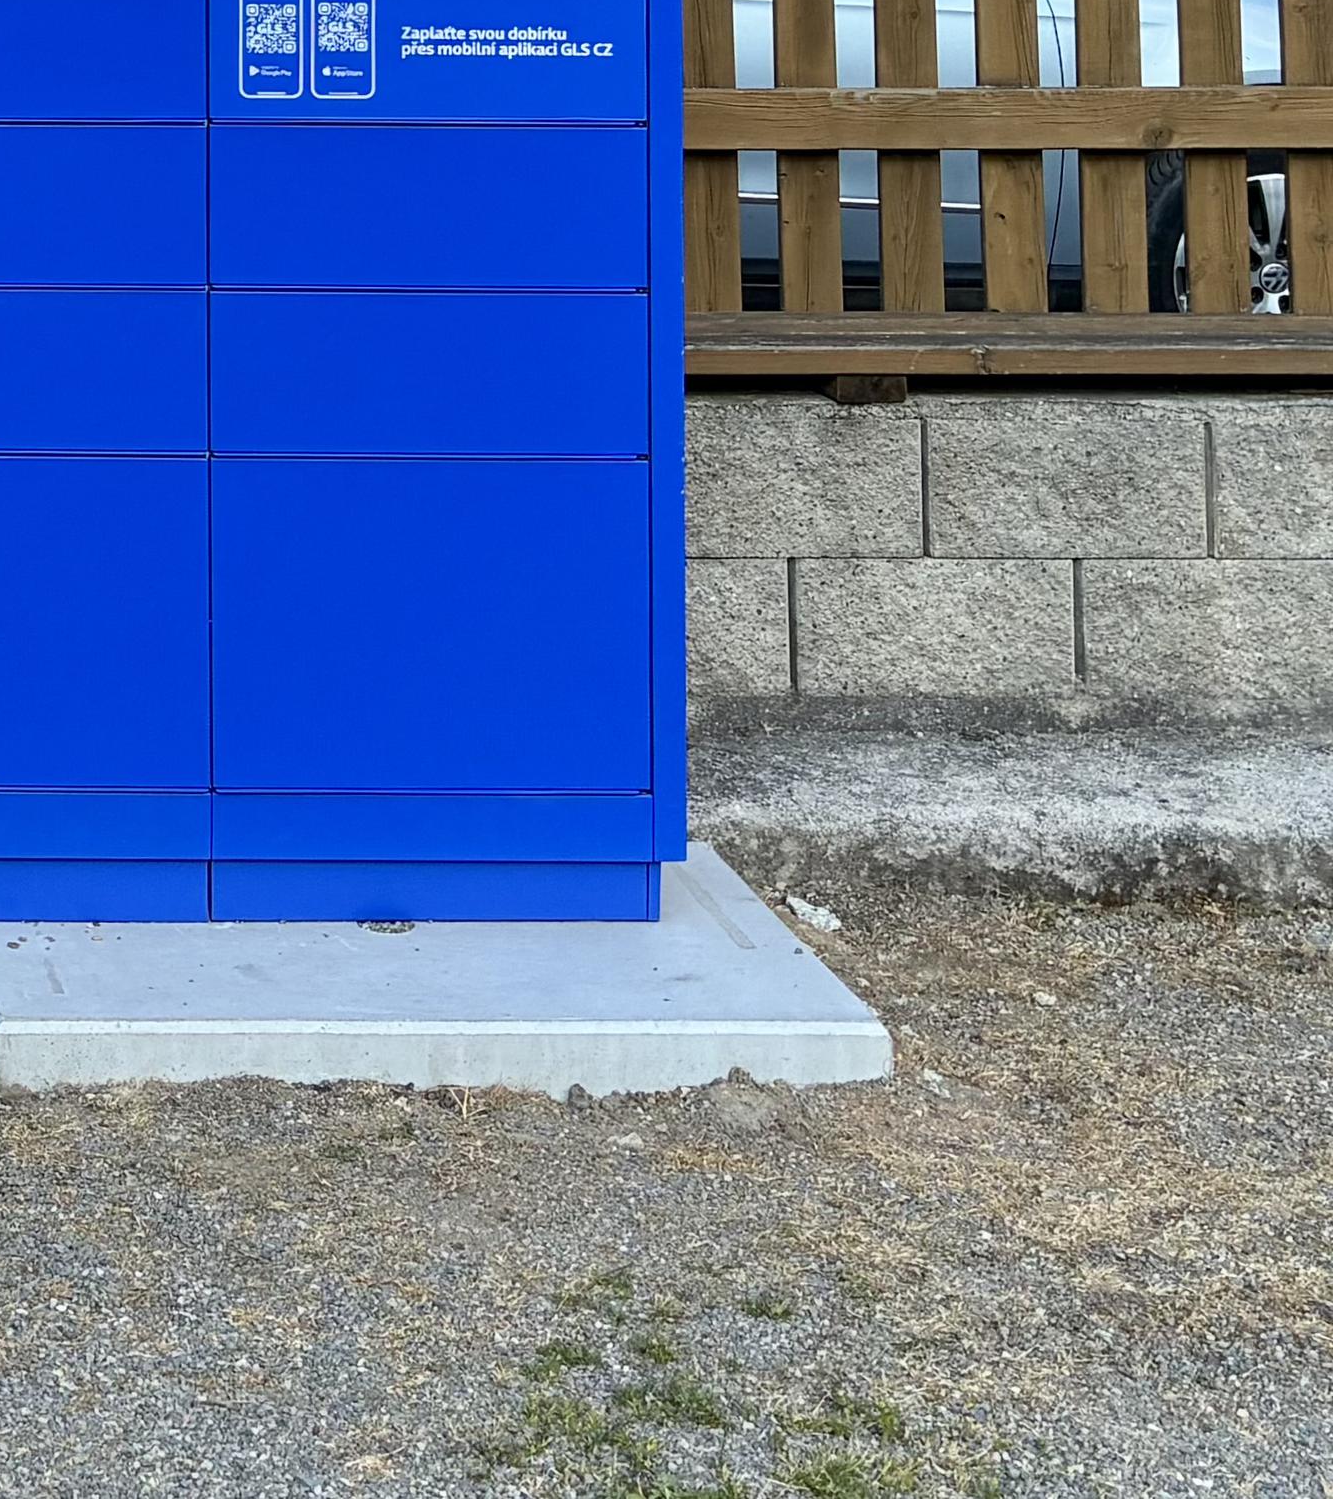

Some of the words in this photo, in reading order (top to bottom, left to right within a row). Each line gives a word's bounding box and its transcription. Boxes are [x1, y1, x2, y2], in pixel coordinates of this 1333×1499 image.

[401, 26, 466, 43] Zaplaťte
[469, 29, 505, 41] svou
[508, 26, 567, 41] dobírku
[401, 42, 435, 59] přes
[437, 42, 496, 56] mobilní
[499, 43, 558, 59] aplikaci
[560, 43, 590, 57] GLS
[593, 43, 614, 57] CZ
